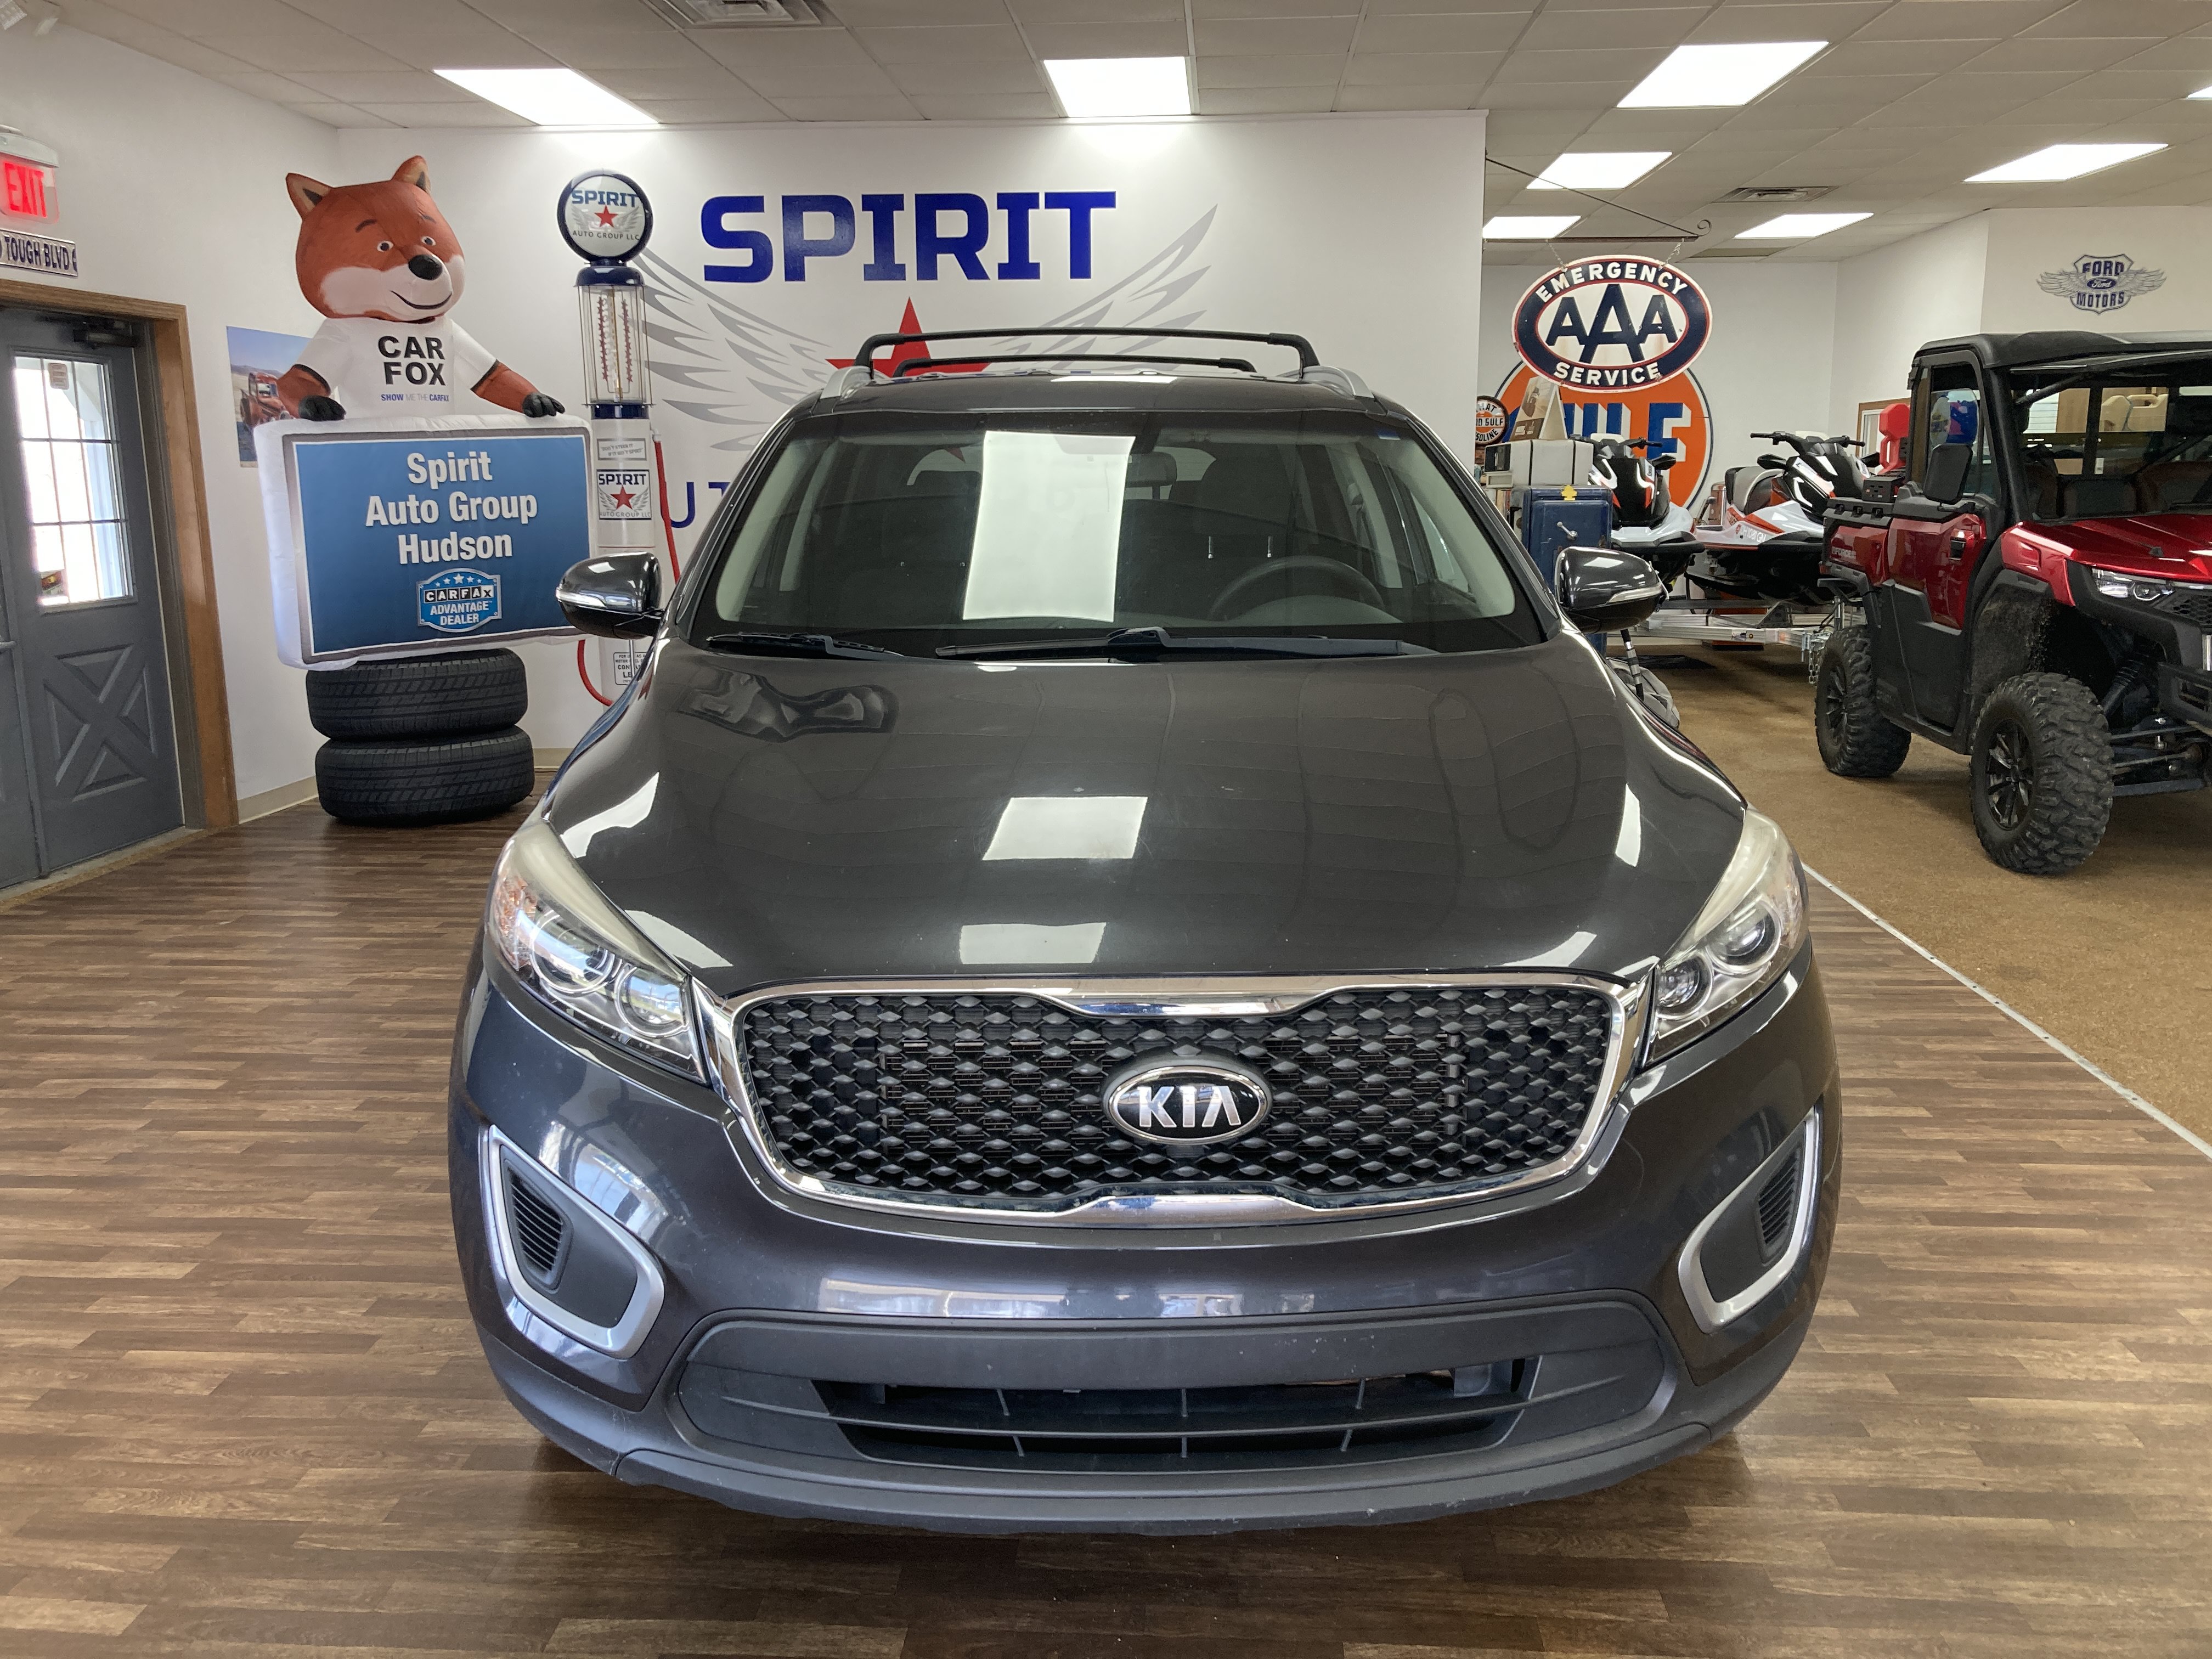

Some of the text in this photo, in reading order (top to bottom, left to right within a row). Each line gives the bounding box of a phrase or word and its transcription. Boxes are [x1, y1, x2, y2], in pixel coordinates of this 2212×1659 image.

[4, 162, 47, 218] EXIT
[572, 190, 638, 207] SPIRIT
[701, 191, 1116, 283] SPIRIT
[4, 236, 41, 266] TOUGH
[44, 243, 69, 270] BLVD
[2083, 261, 2124, 275] FORD
[1536, 262, 1688, 303] EMERGENCY
[2091, 279, 2112, 288] Ford
[2077, 291, 2124, 308] MOTORS
[1545, 283, 1679, 364] AAA
[378, 336, 443, 359] CAR
[383, 362, 446, 386] FOX
[1554, 362, 1661, 386] SERVICE
[407, 451, 493, 489] Spirit
[599, 474, 646, 485] SPIRIT
[365, 491, 538, 527] Auto Group
[398, 531, 512, 564] Hudson
[1757, 532, 1766, 543] GN
[425, 586, 492, 602] CARFAX
[430, 601, 489, 615] ADVANTAGE
[441, 613, 479, 625] DEALER
[1137, 1086, 1241, 1128] KIA
